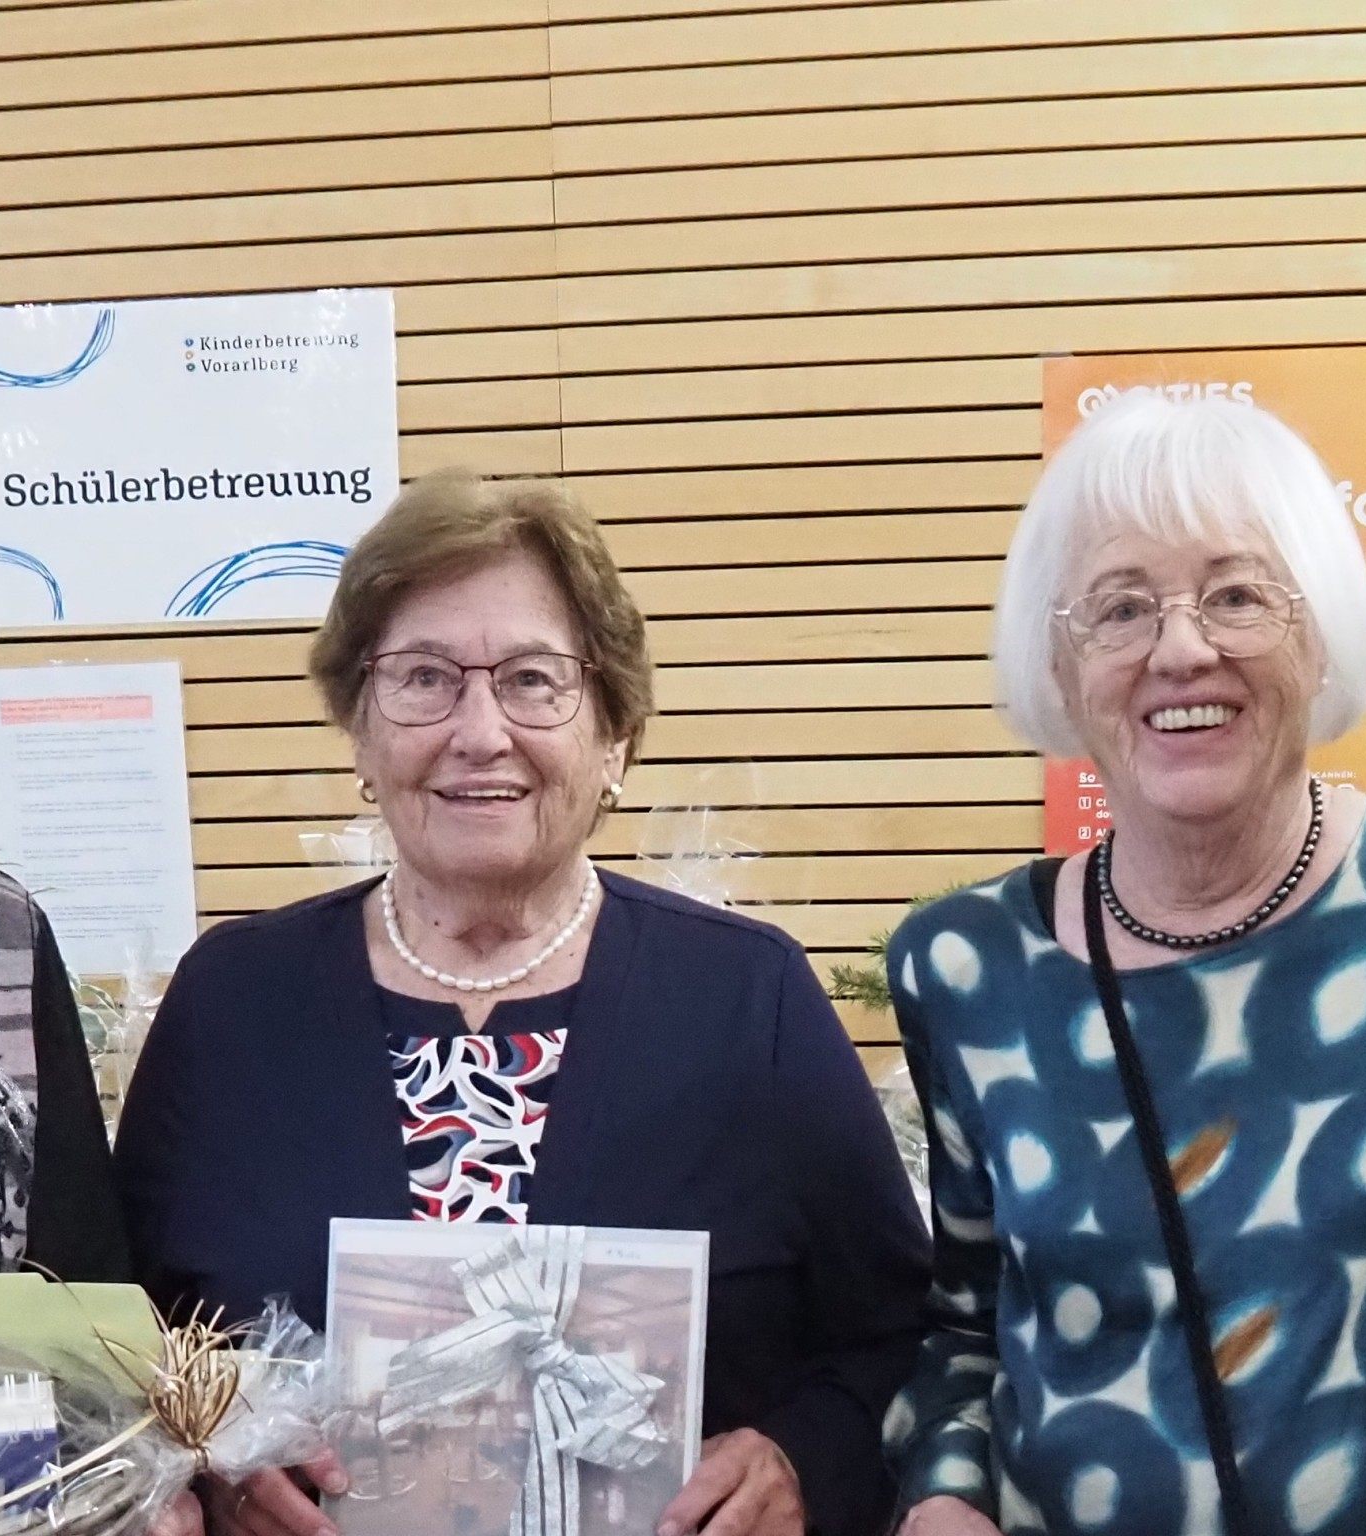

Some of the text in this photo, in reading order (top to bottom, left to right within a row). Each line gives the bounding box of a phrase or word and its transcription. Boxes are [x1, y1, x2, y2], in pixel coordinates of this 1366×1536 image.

[200, 331, 359, 352] Kinderbetreuung
[201, 356, 299, 374] Vorarlberg
[3, 465, 372, 508] Schülerbetreuung
